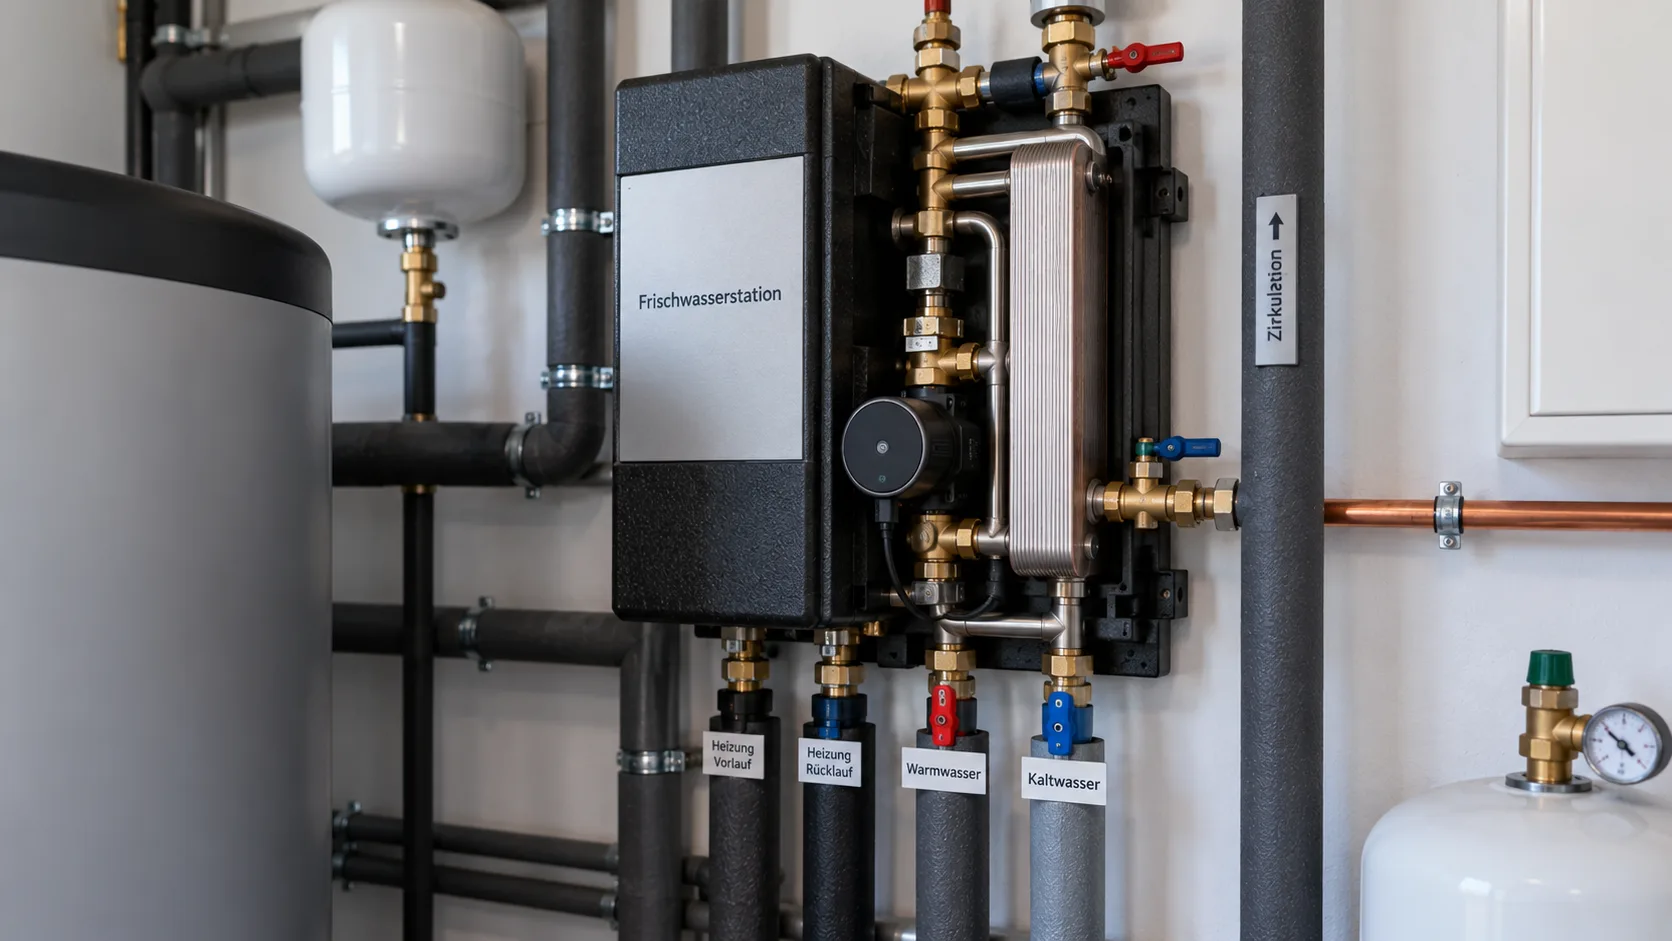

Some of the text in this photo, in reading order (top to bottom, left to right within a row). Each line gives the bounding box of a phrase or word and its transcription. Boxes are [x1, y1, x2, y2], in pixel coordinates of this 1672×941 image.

[639, 286, 782, 310] Frischwasserstation
[1267, 249, 1284, 342] Zirkulation
[711, 740, 755, 757] Heizung
[807, 746, 852, 764] Heizung
[713, 756, 752, 770] Vorlauf
[806, 763, 854, 778] Rücklauf
[906, 762, 982, 780] Warmwasser
[1028, 772, 1101, 791] Kaltwasser
